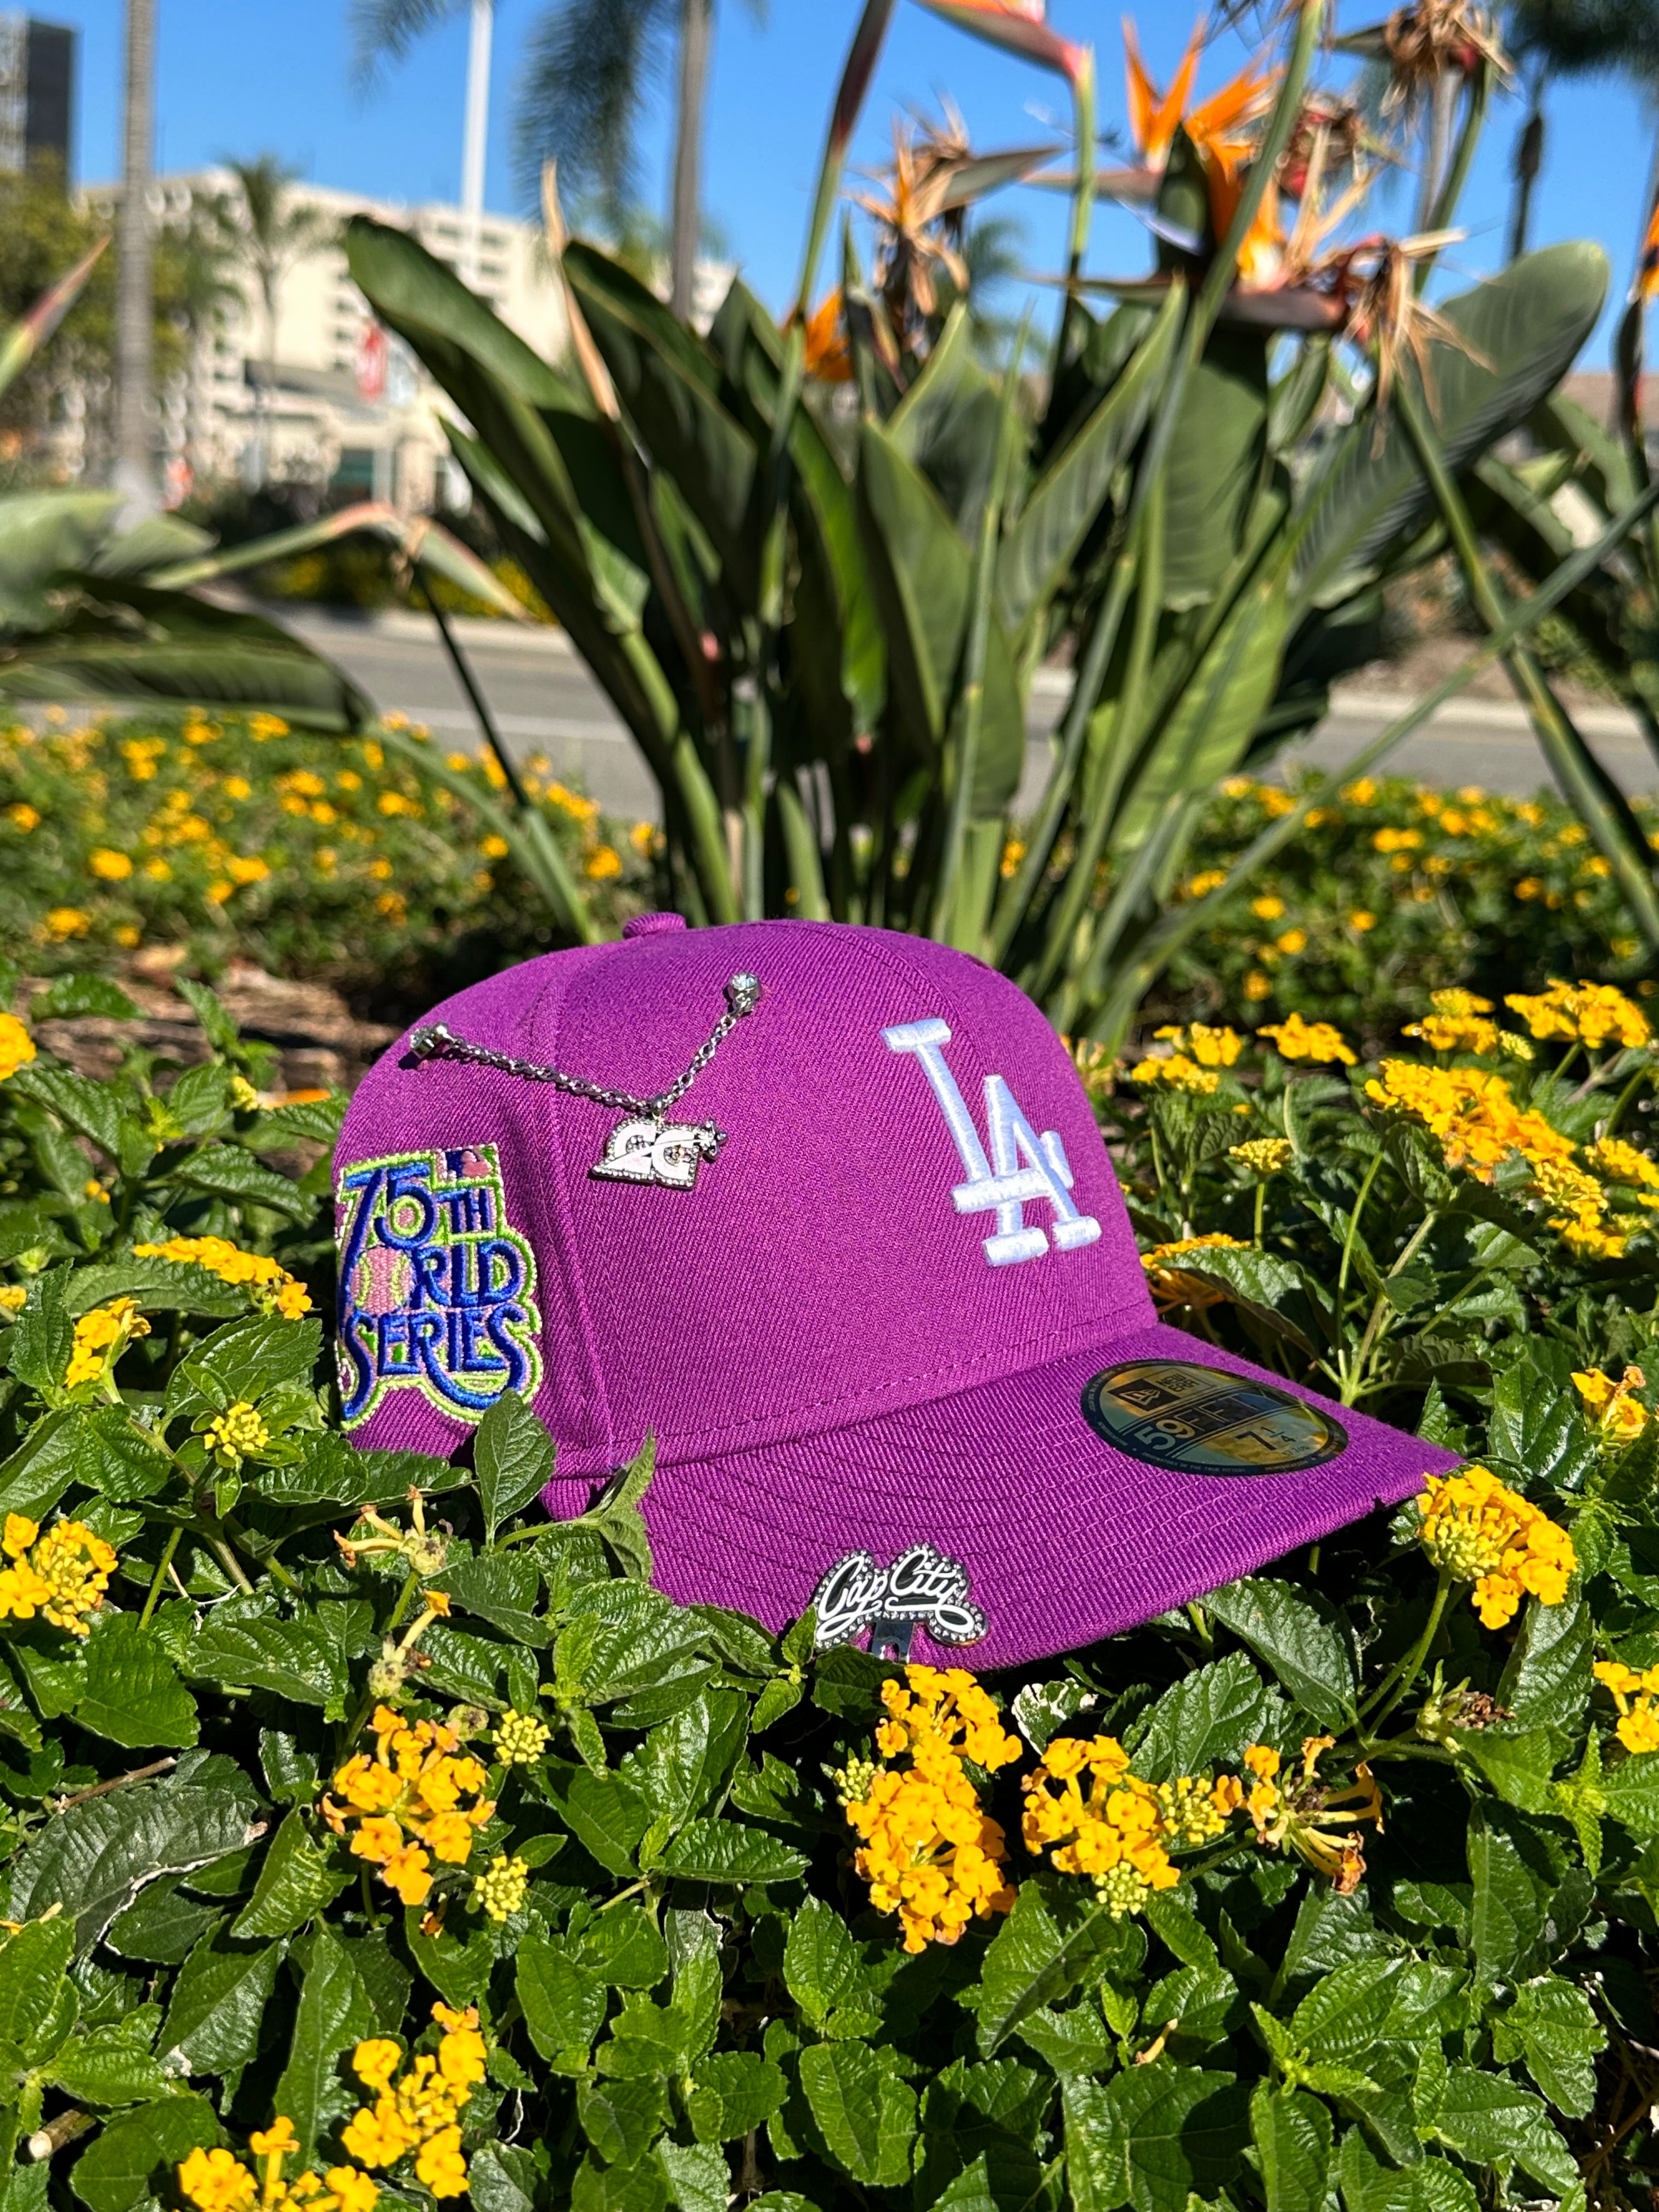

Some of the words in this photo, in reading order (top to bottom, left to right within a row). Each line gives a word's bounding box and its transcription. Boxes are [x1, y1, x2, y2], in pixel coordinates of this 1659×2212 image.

[879, 1017, 1102, 1266] LA
[342, 1303, 526, 1420] SERIES
[1155, 1373, 1187, 1387] NEW
[1168, 1379, 1200, 1392] ERA
[1133, 1389, 1283, 1451] 59FIFTY
[1235, 1431, 1277, 1451] 7
[816, 1555, 888, 1640] Cap
[884, 1549, 975, 1634] City
